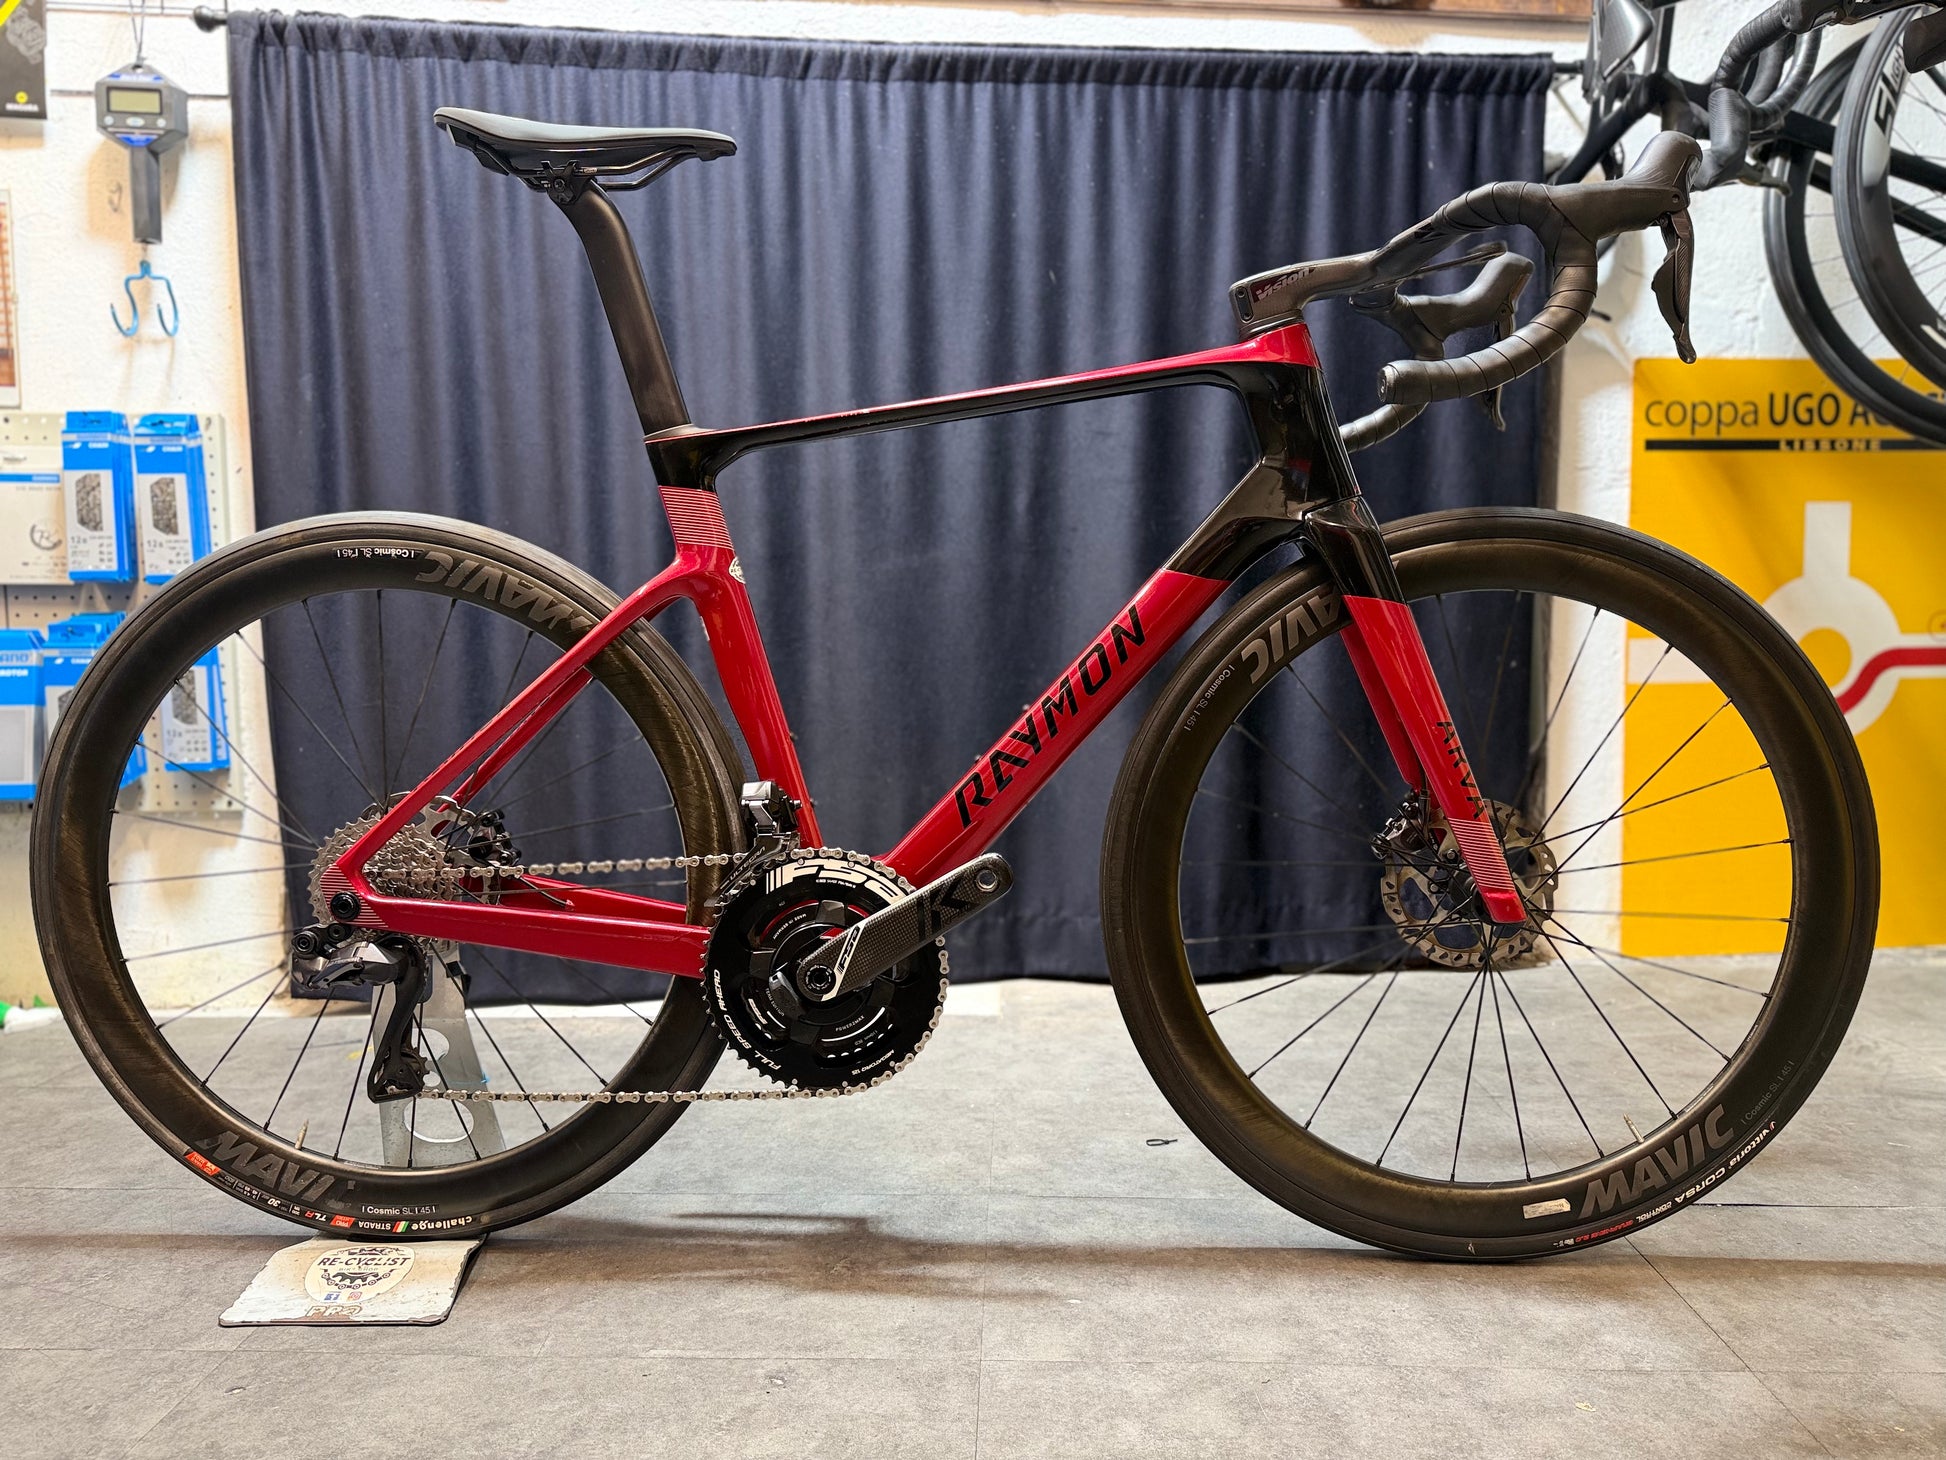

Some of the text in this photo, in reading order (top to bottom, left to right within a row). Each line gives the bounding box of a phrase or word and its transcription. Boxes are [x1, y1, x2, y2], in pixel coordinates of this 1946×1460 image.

[1645, 400, 1759, 436] coppa
[1769, 393, 1840, 426] UGO
[415, 551, 593, 631] MAVIC
[1240, 592, 1342, 684] AVIC
[1204, 669, 1232, 699] Cosmic
[954, 604, 1146, 829] RAYMON
[713, 968, 782, 1071] FULL SPEED AHEAD
[195, 1130, 336, 1202] MAVI
[1577, 1104, 1735, 1220] MAVIC
[1674, 1171, 1727, 1204] CORSA
[358, 1215, 473, 1232] challenge STRADA
[367, 1205, 431, 1215] Cosmic SL 45
[317, 1257, 411, 1267] RE-CYCLIST
